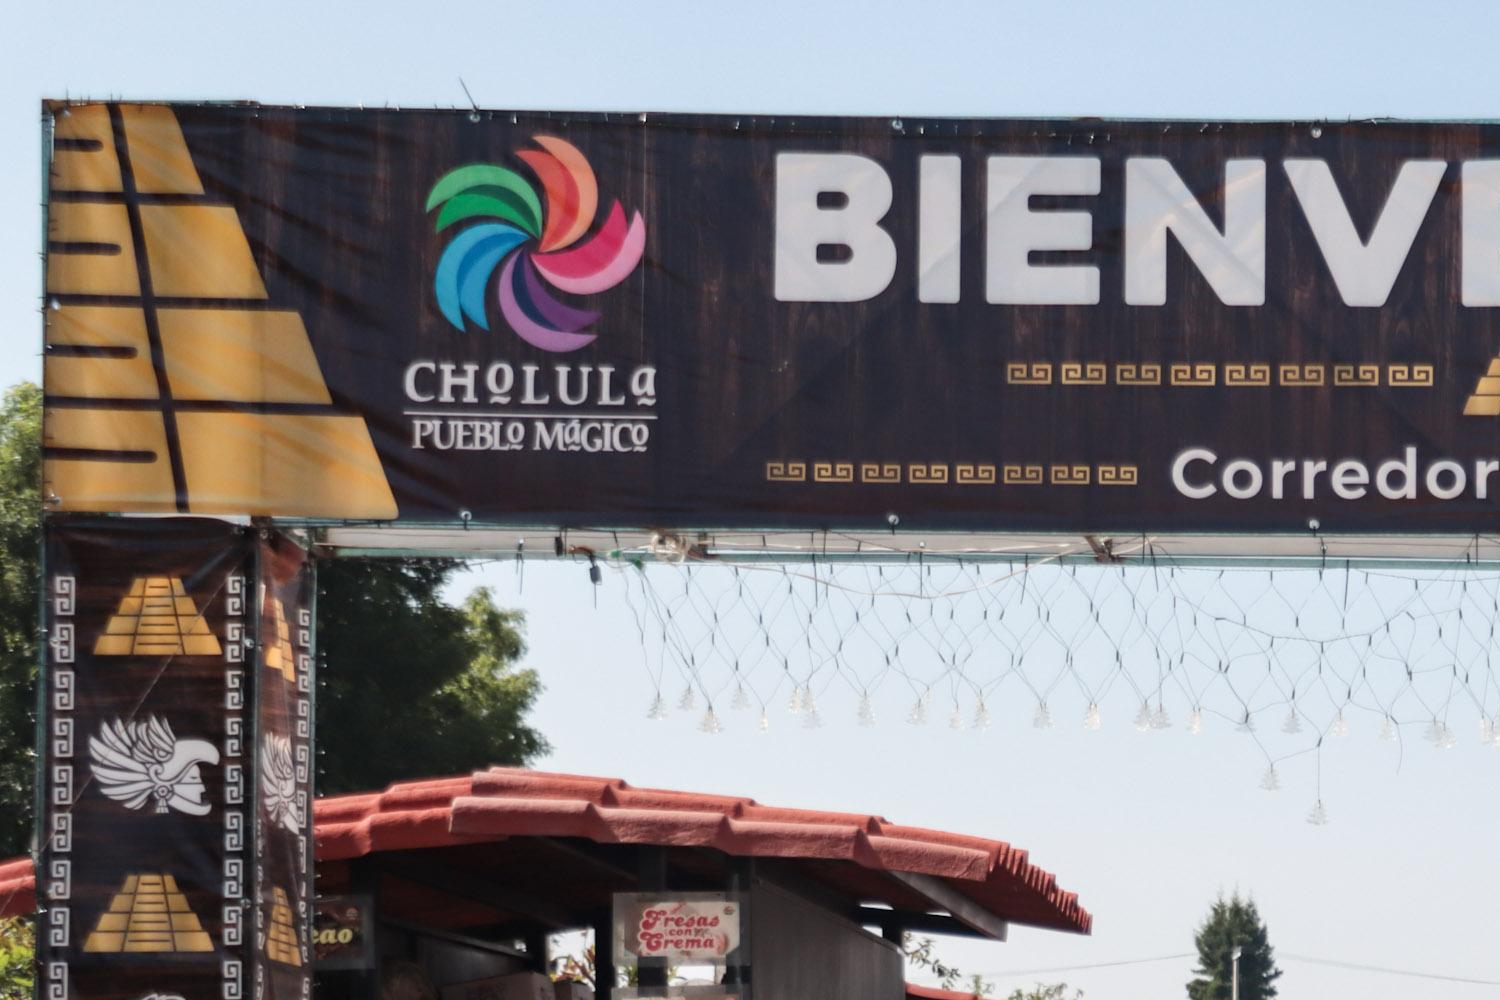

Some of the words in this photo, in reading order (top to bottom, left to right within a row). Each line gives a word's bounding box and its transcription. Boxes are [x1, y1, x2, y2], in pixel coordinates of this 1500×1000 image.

[1170, 446, 1500, 501] Corredor
[641, 909, 720, 931] Fresas
[312, 928, 353, 944] cao
[639, 931, 714, 951] Crema
[668, 928, 692, 936] con
